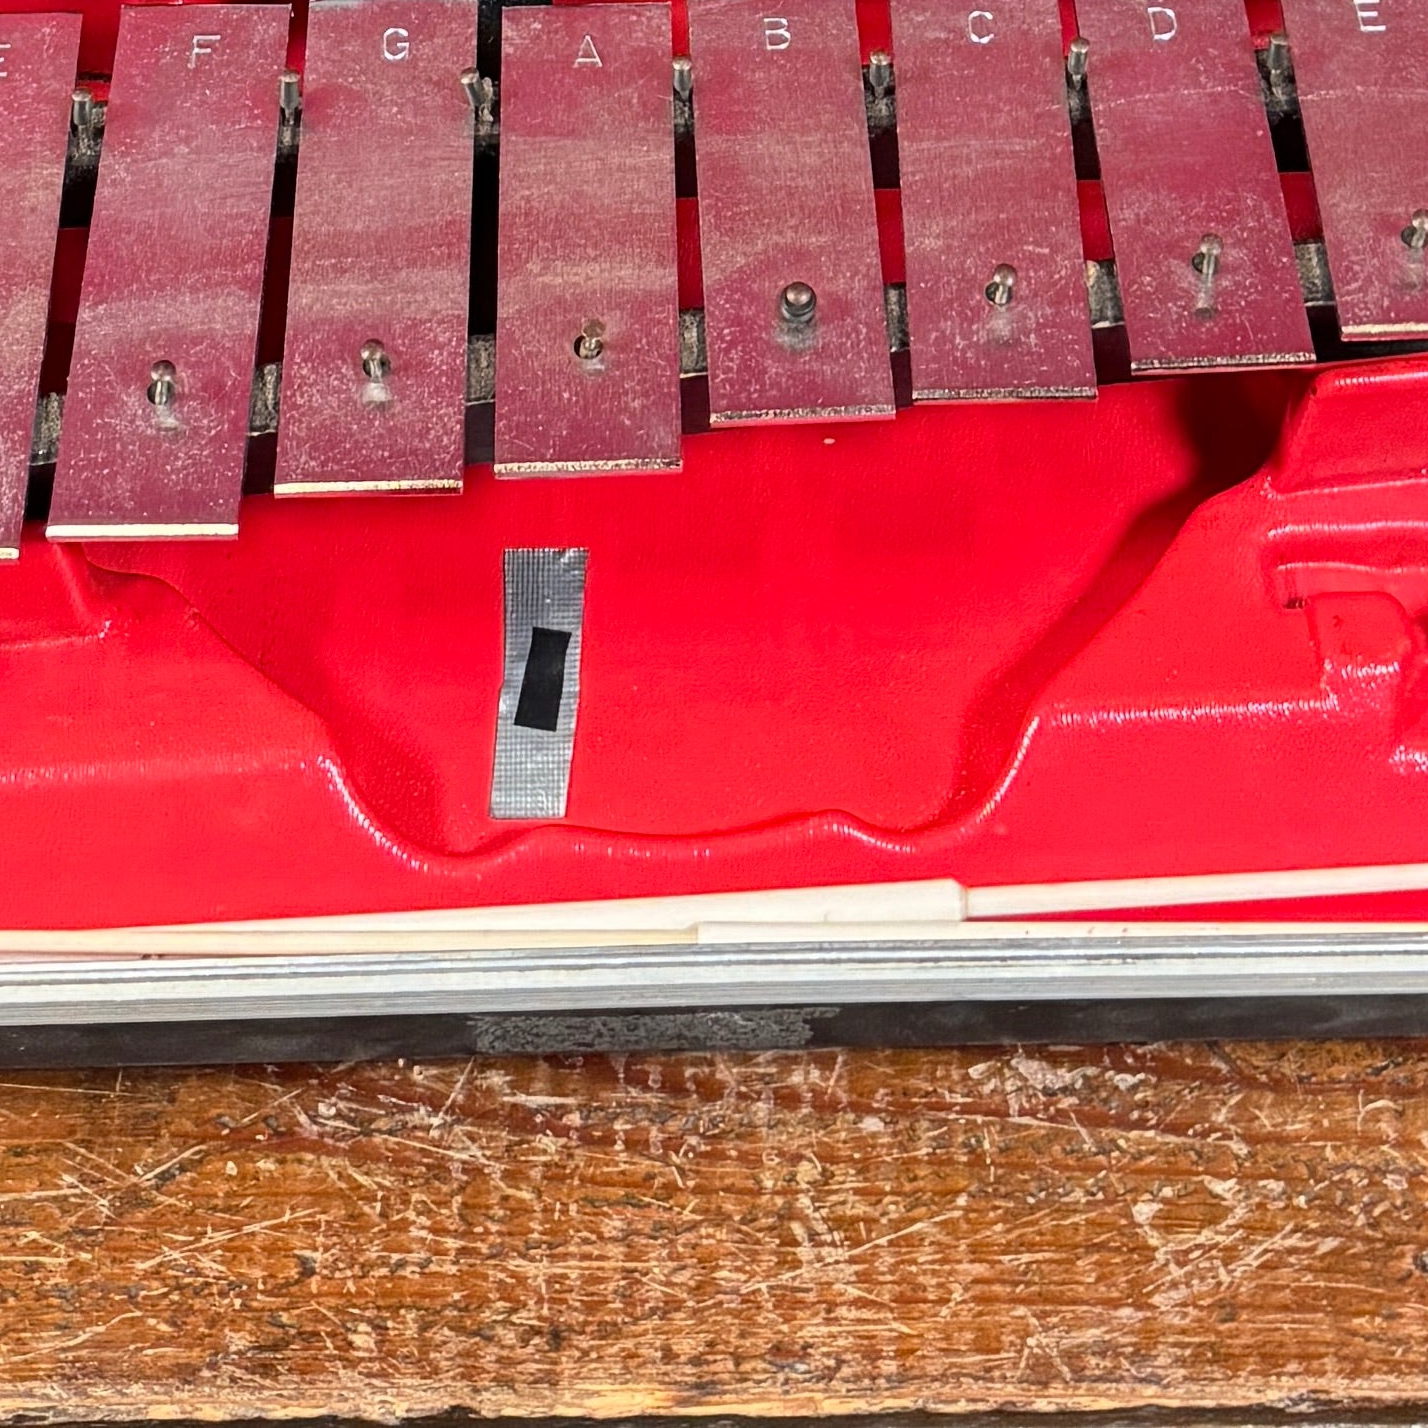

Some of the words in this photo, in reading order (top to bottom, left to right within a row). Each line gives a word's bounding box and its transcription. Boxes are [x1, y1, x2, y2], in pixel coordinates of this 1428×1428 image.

[764, 17, 791, 50] B
[968, 11, 995, 44] C
[1148, 7, 1176, 40] D
[192, 34, 221, 69] F
[382, 27, 409, 61] G
[573, 35, 602, 68] A
